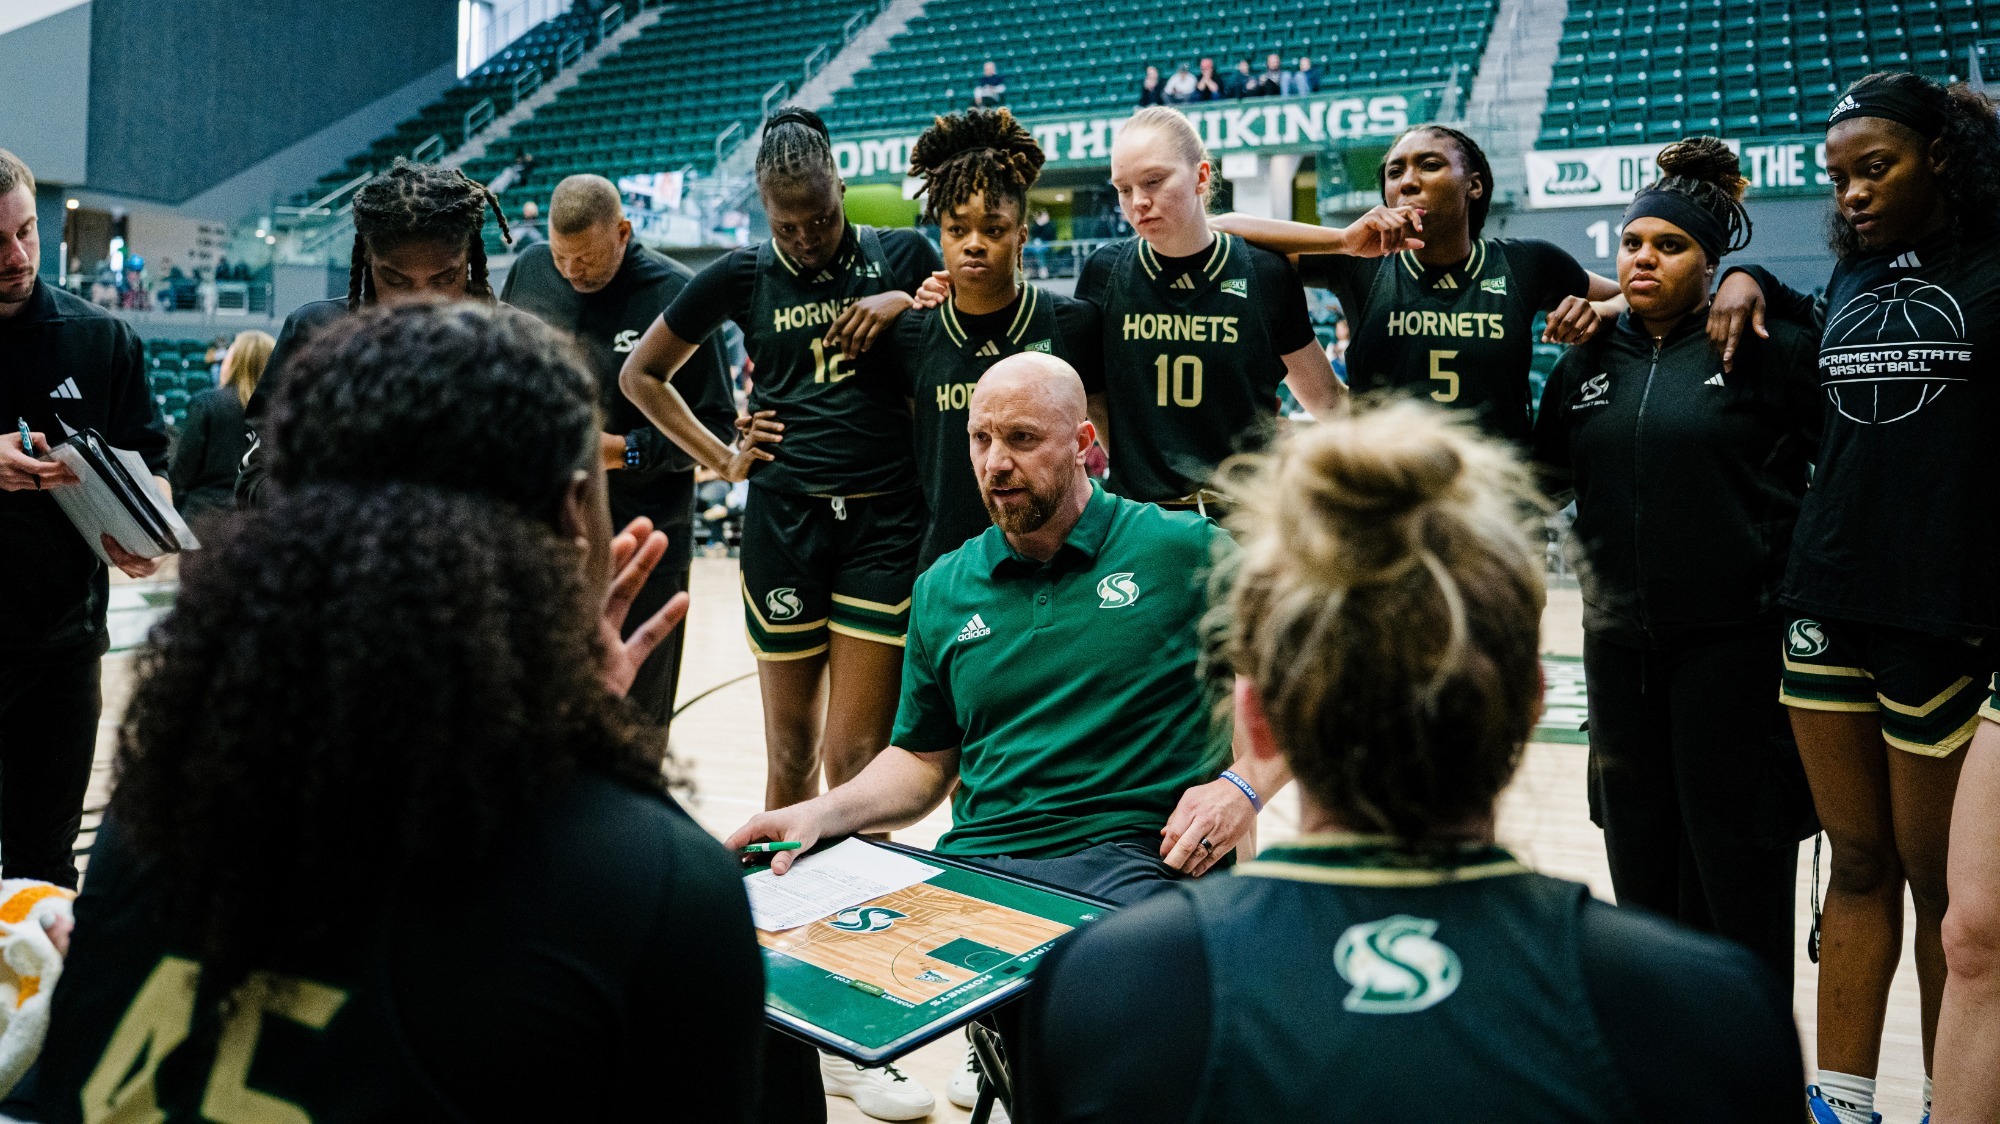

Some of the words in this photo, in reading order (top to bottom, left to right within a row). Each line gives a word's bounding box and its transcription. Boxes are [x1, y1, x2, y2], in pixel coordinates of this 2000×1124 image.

[1744, 143, 1807, 188] THE
[1122, 313, 1239, 344] HORNETS
[1386, 311, 1505, 340] HORNETS
[1828, 361, 1932, 377] BASKETBALL
[1907, 349, 1973, 362] STATE
[1154, 353, 1204, 408] 10
[1429, 349, 1460, 403] 5
[957, 627, 991, 642] adidas
